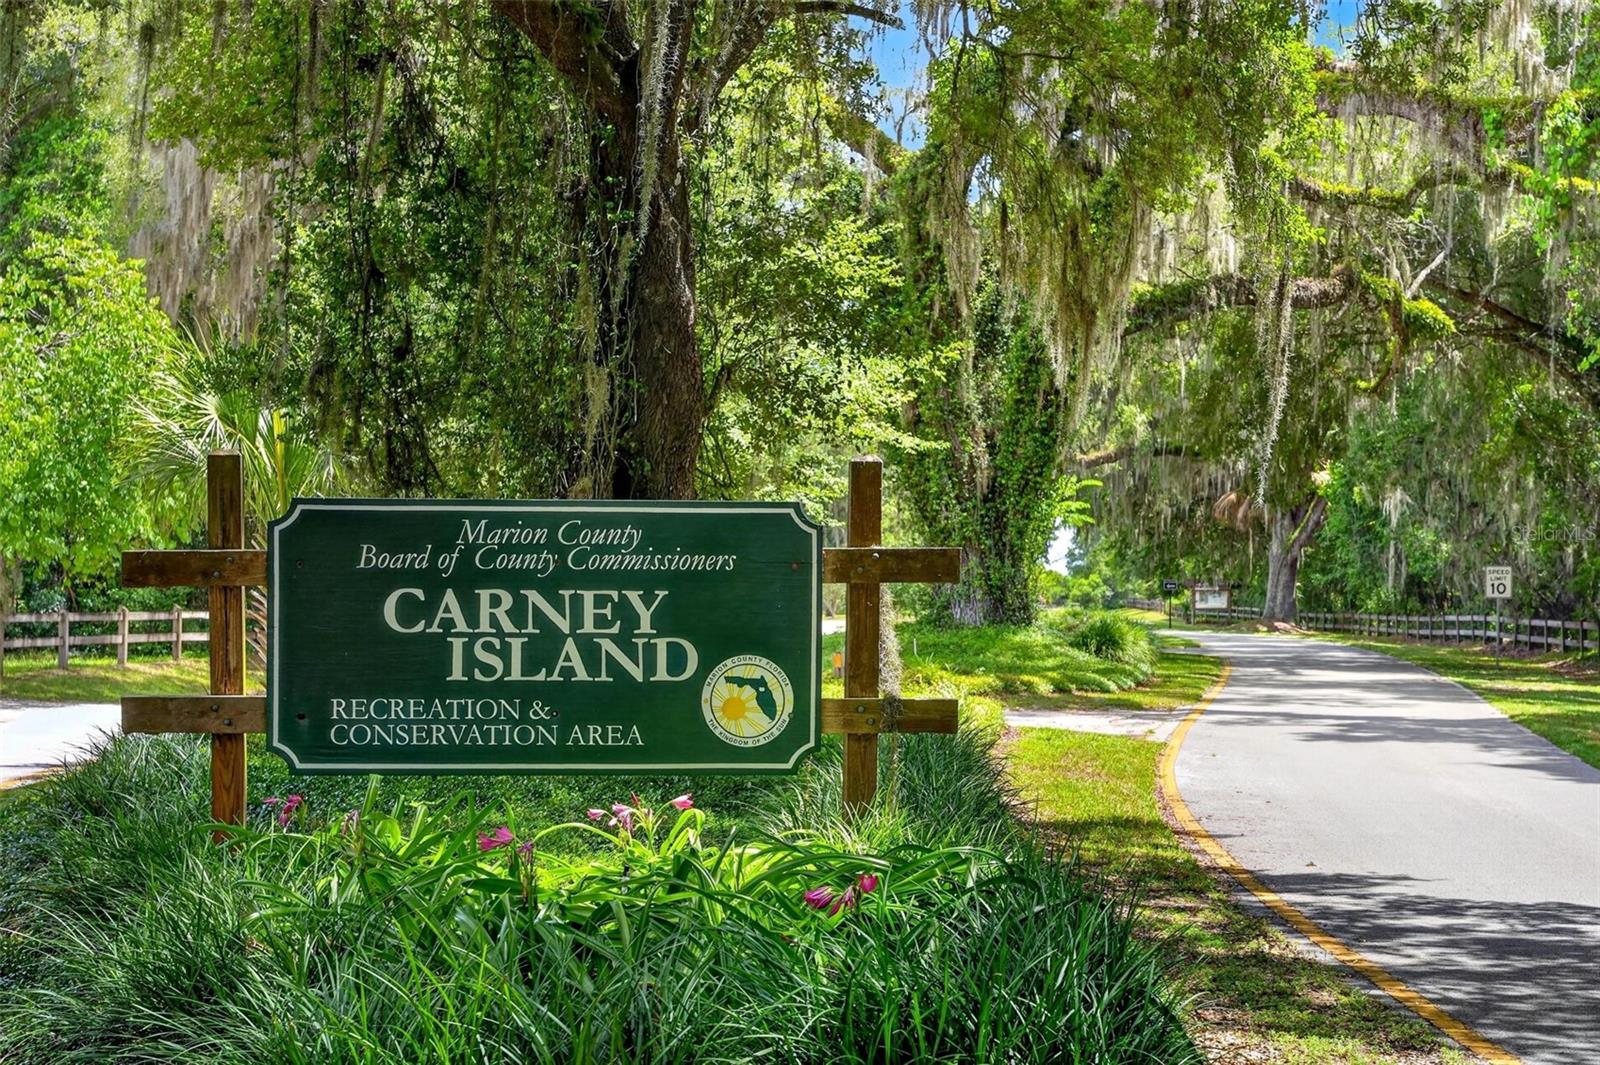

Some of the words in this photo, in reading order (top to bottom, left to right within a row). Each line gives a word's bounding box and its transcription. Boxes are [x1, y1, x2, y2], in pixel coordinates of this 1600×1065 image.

[455, 519, 548, 545] Marion
[557, 519, 642, 554] County
[357, 544, 432, 569] Board
[437, 544, 465, 578] of
[474, 544, 558, 578] County
[567, 545, 737, 571] Commissioners
[1491, 583, 1507, 594] 10
[383, 587, 669, 635] CARNEY
[446, 636, 699, 683] ISLAND
[706, 662, 729, 688] MARION
[730, 656, 762, 665] COUNTY
[765, 661, 790, 688] FLORIDA
[330, 698, 521, 720] RECREATION
[529, 700, 551, 720] &
[330, 724, 558, 746] CONSERVATION
[566, 724, 644, 746] AREA
[707, 718, 718, 731] THE
[718, 730, 749, 746] KINGDOM
[763, 731, 776, 742] THE
[775, 718, 787, 732] SUN
